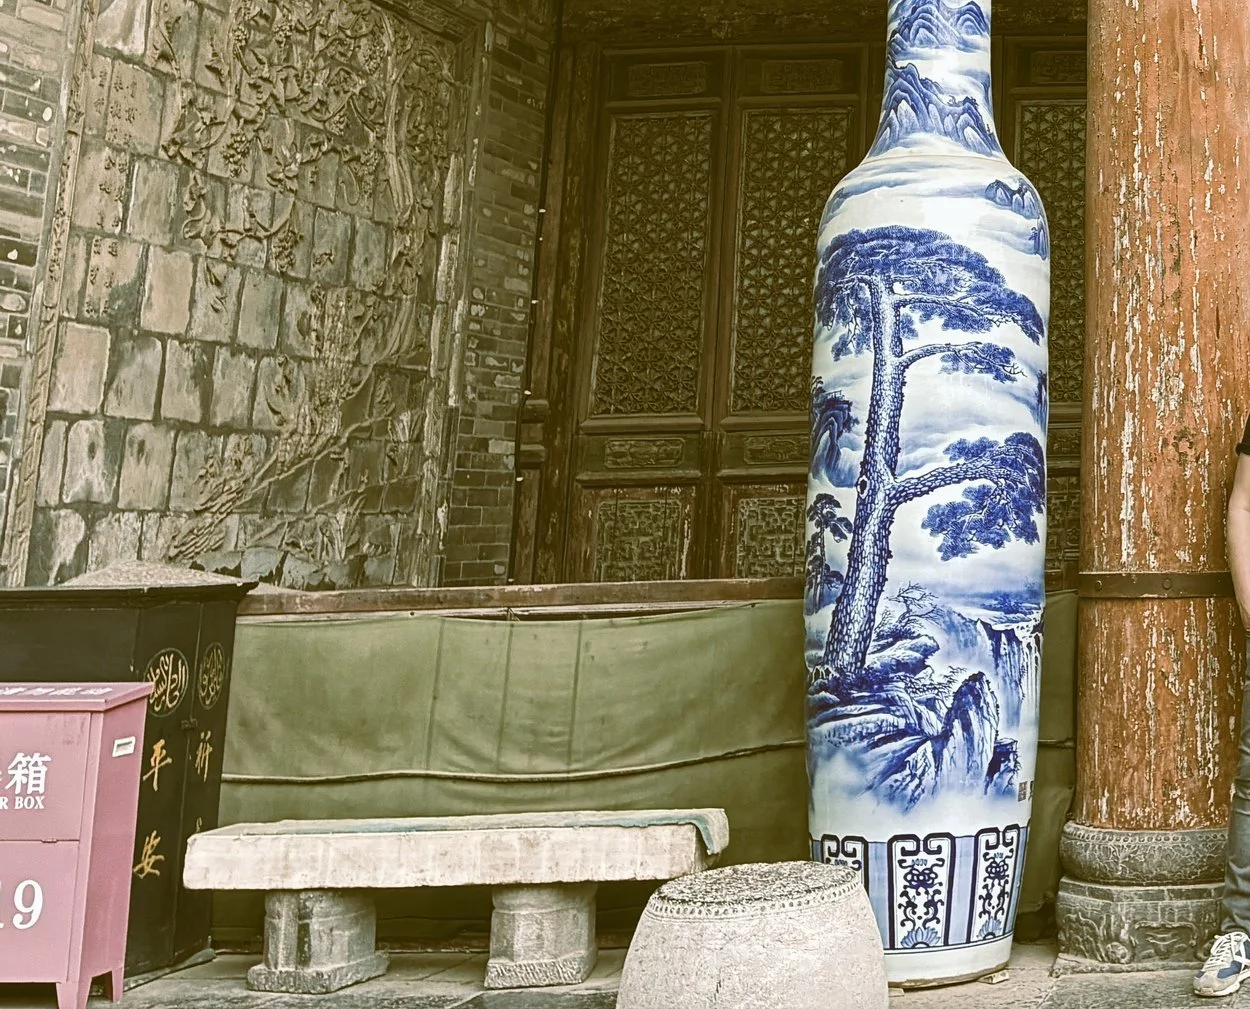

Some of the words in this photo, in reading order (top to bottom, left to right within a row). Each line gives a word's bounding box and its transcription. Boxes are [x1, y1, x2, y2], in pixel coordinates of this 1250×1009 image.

[0, 752, 52, 795] 箱
[14, 796, 46, 810] BOX
[0, 879, 44, 930] 9
